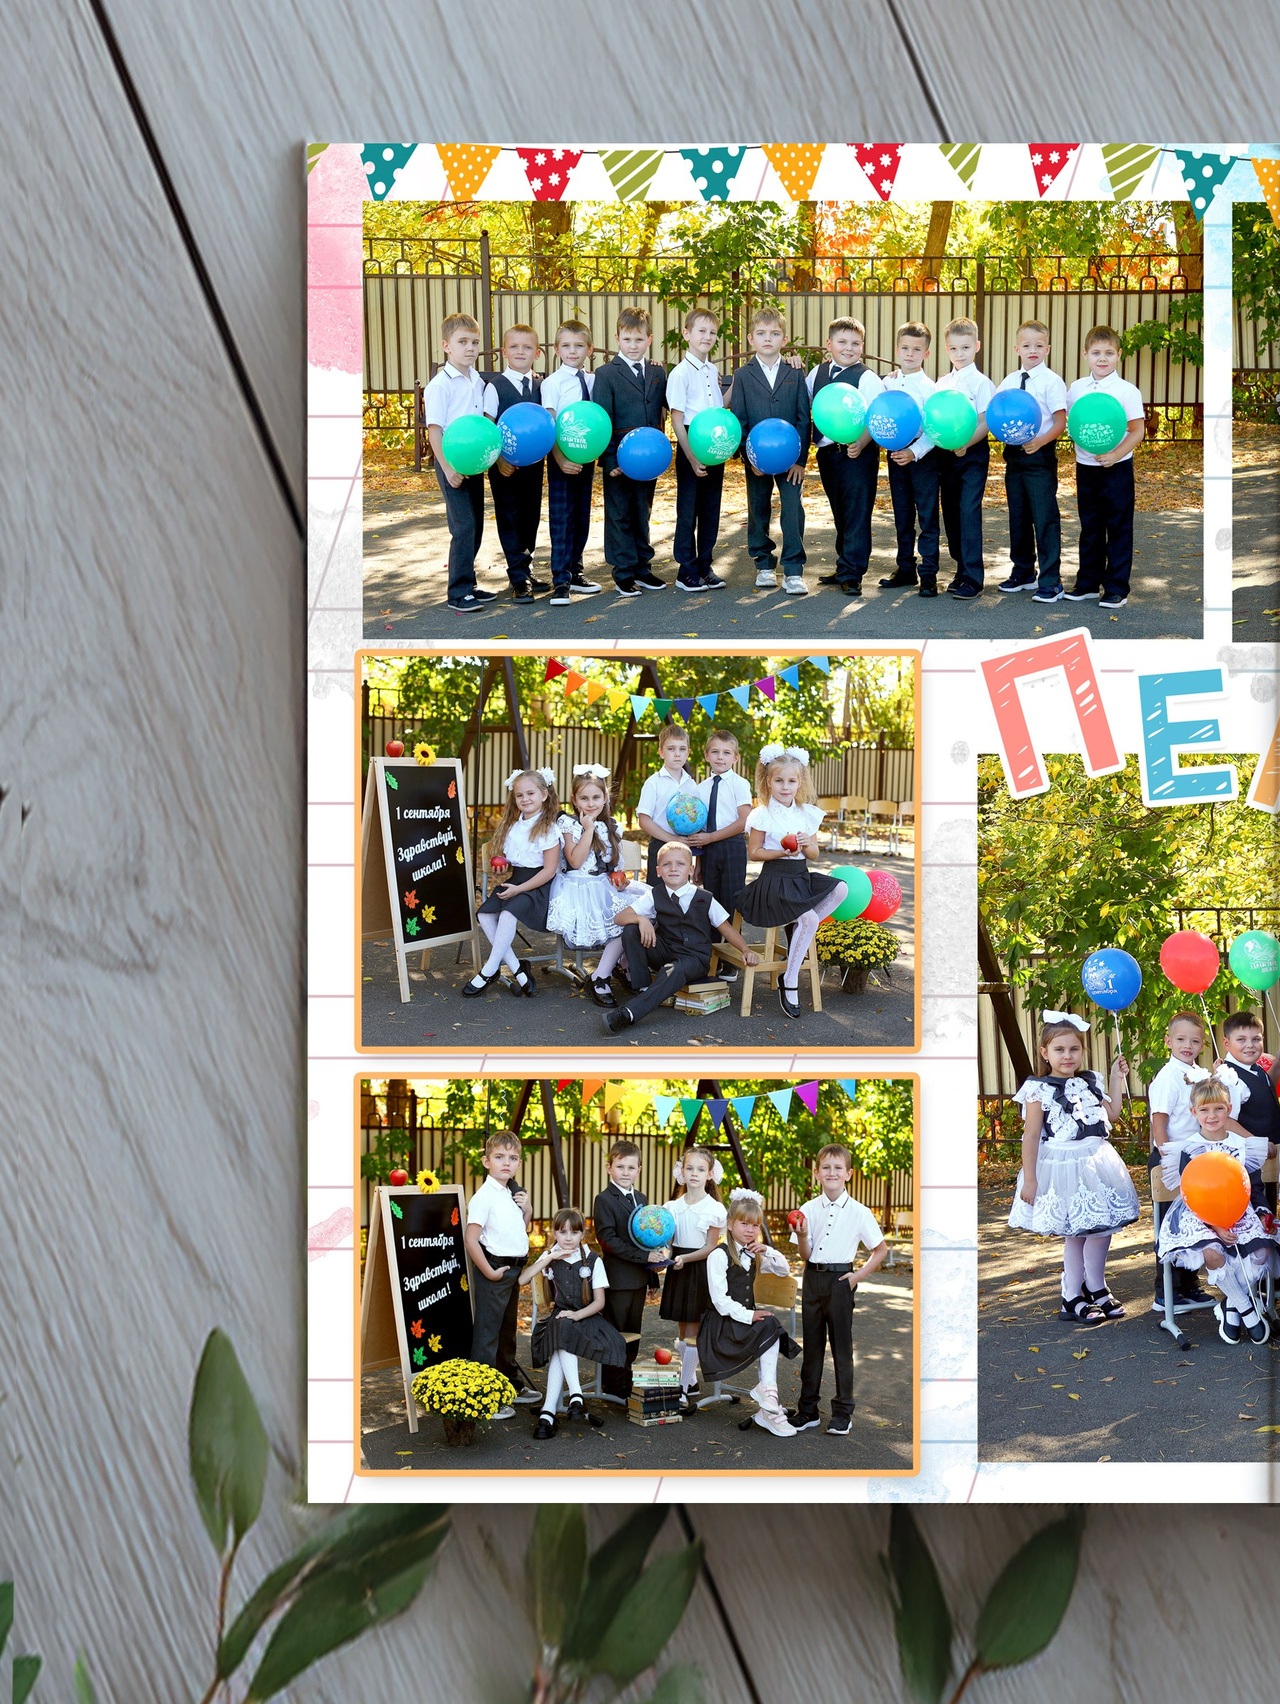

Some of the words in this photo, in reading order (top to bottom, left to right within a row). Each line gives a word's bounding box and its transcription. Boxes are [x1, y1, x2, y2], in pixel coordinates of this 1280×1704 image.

[396, 806, 400, 820] 1
[403, 805, 451, 822] сентября
[397, 825, 457, 862] Здравствуй,
[401, 1235, 406, 1249] 1
[408, 1233, 455, 1250] сентября
[403, 1252, 461, 1292] Здравствуй,
